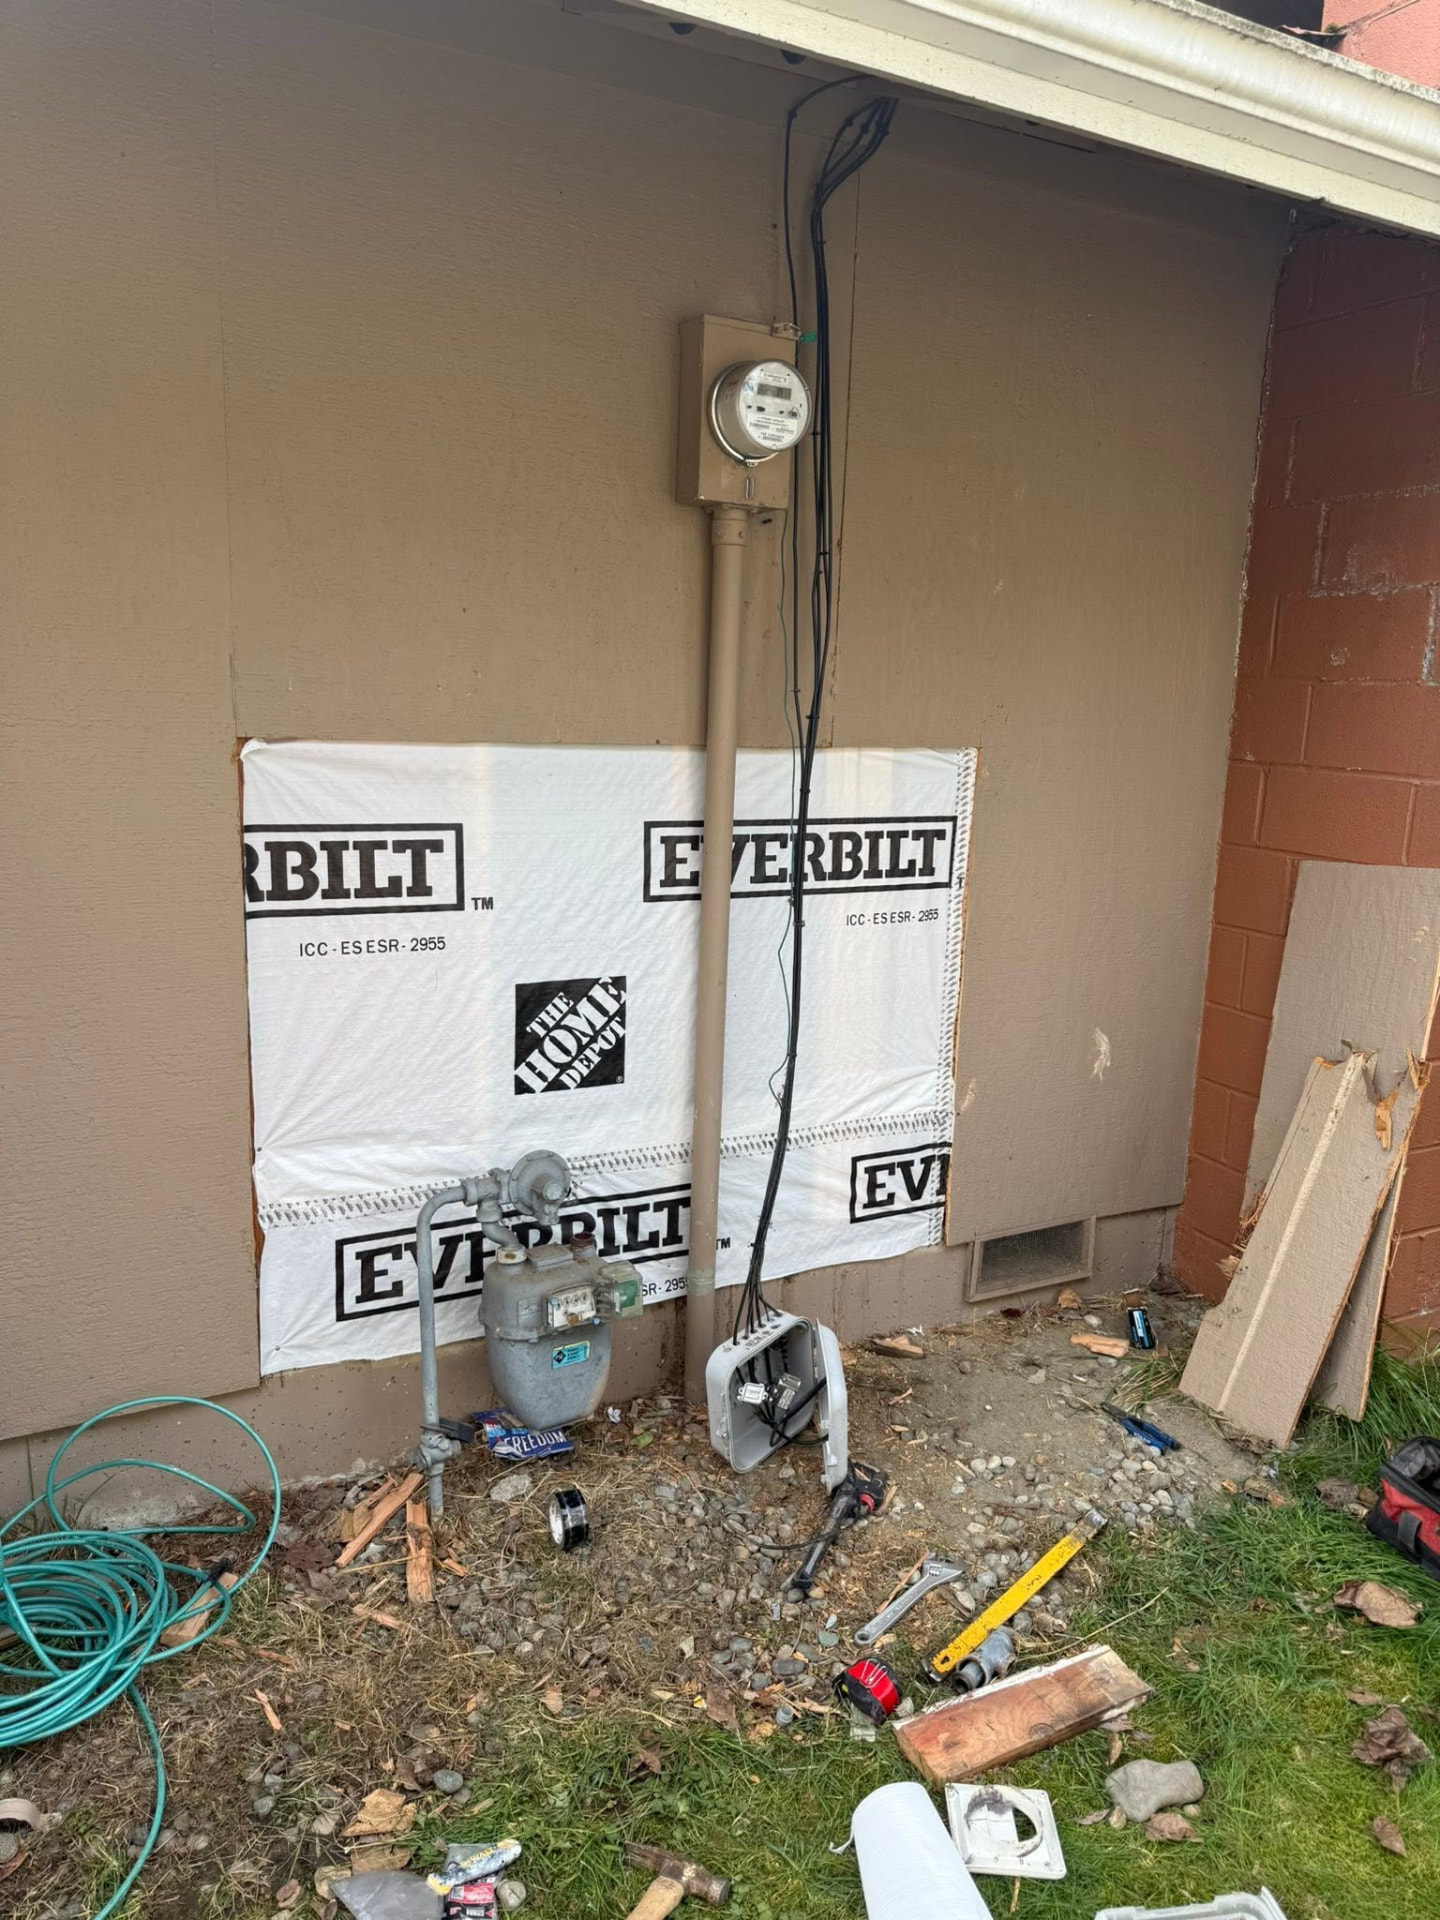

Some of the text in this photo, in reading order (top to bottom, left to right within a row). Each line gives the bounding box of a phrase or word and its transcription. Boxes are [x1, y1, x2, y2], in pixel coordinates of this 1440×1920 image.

[471, 896, 494, 911] TM
[514, 976, 626, 1093] HOME
[526, 991, 574, 1038] THE
[559, 1016, 626, 1090] DEPOT
